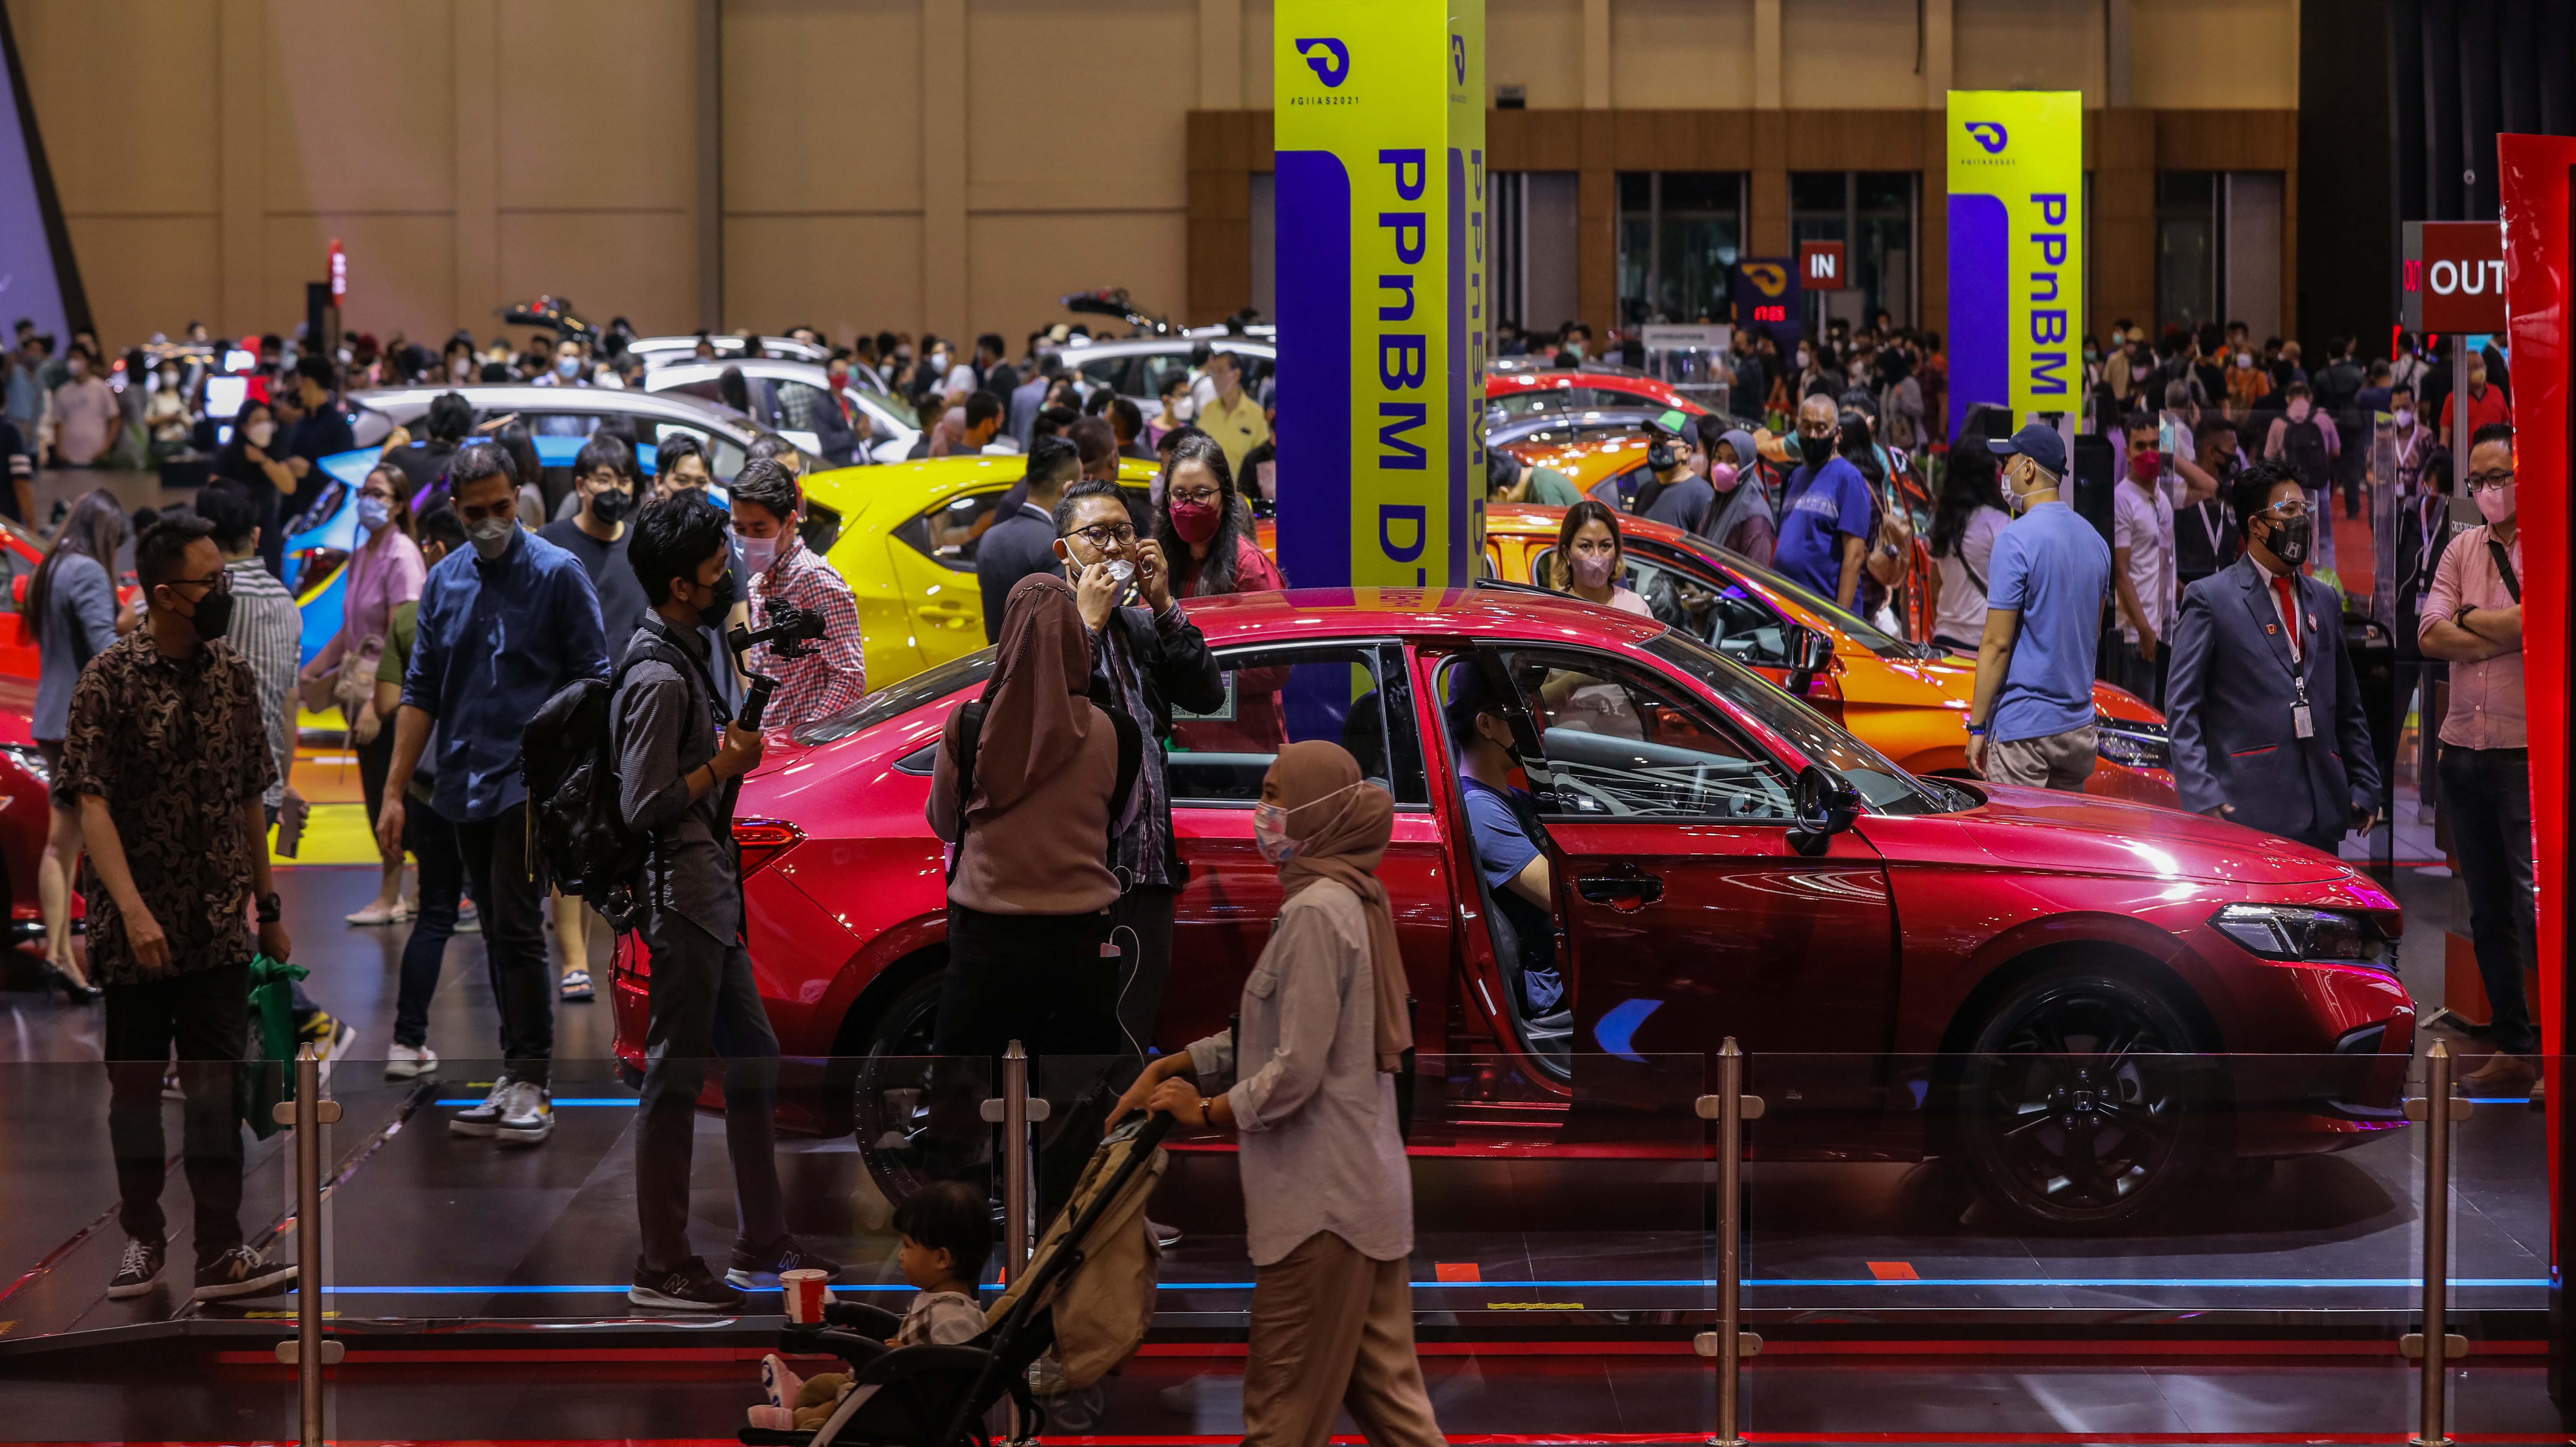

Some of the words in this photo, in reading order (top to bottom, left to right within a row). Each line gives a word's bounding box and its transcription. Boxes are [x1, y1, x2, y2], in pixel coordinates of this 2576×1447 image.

[1291, 96, 1359, 105] #GIIAS2021
[1810, 253, 1835, 278] IN
[2404, 258, 2422, 292] OUT
[2430, 259, 2505, 295] OUT
[1379, 148, 1426, 469] PPnBM
[2031, 193, 2067, 394] PPnBM
